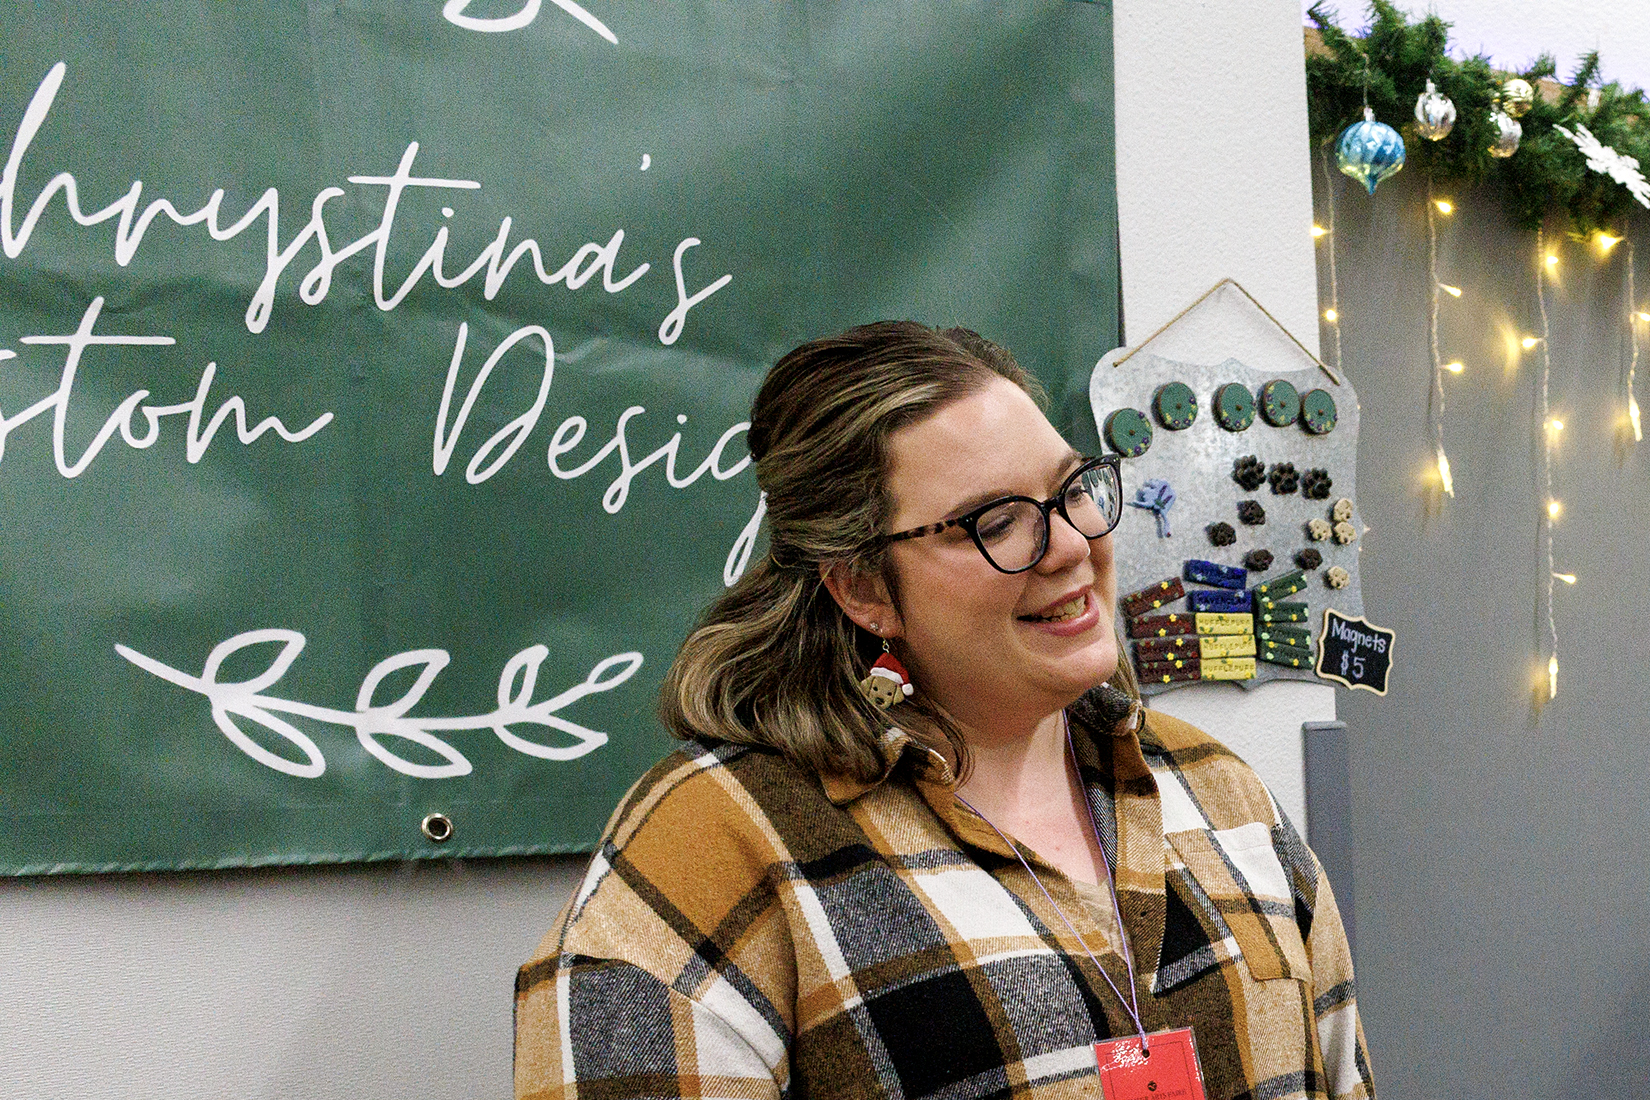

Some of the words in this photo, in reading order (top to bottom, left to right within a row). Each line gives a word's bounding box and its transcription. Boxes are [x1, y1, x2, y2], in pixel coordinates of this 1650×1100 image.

[0, 62, 732, 345] hrystina's
[0, 297, 333, 478] stom
[434, 323, 770, 587] Desig
[1331, 617, 1386, 653] Magnets
[1340, 649, 1366, 679] $5
